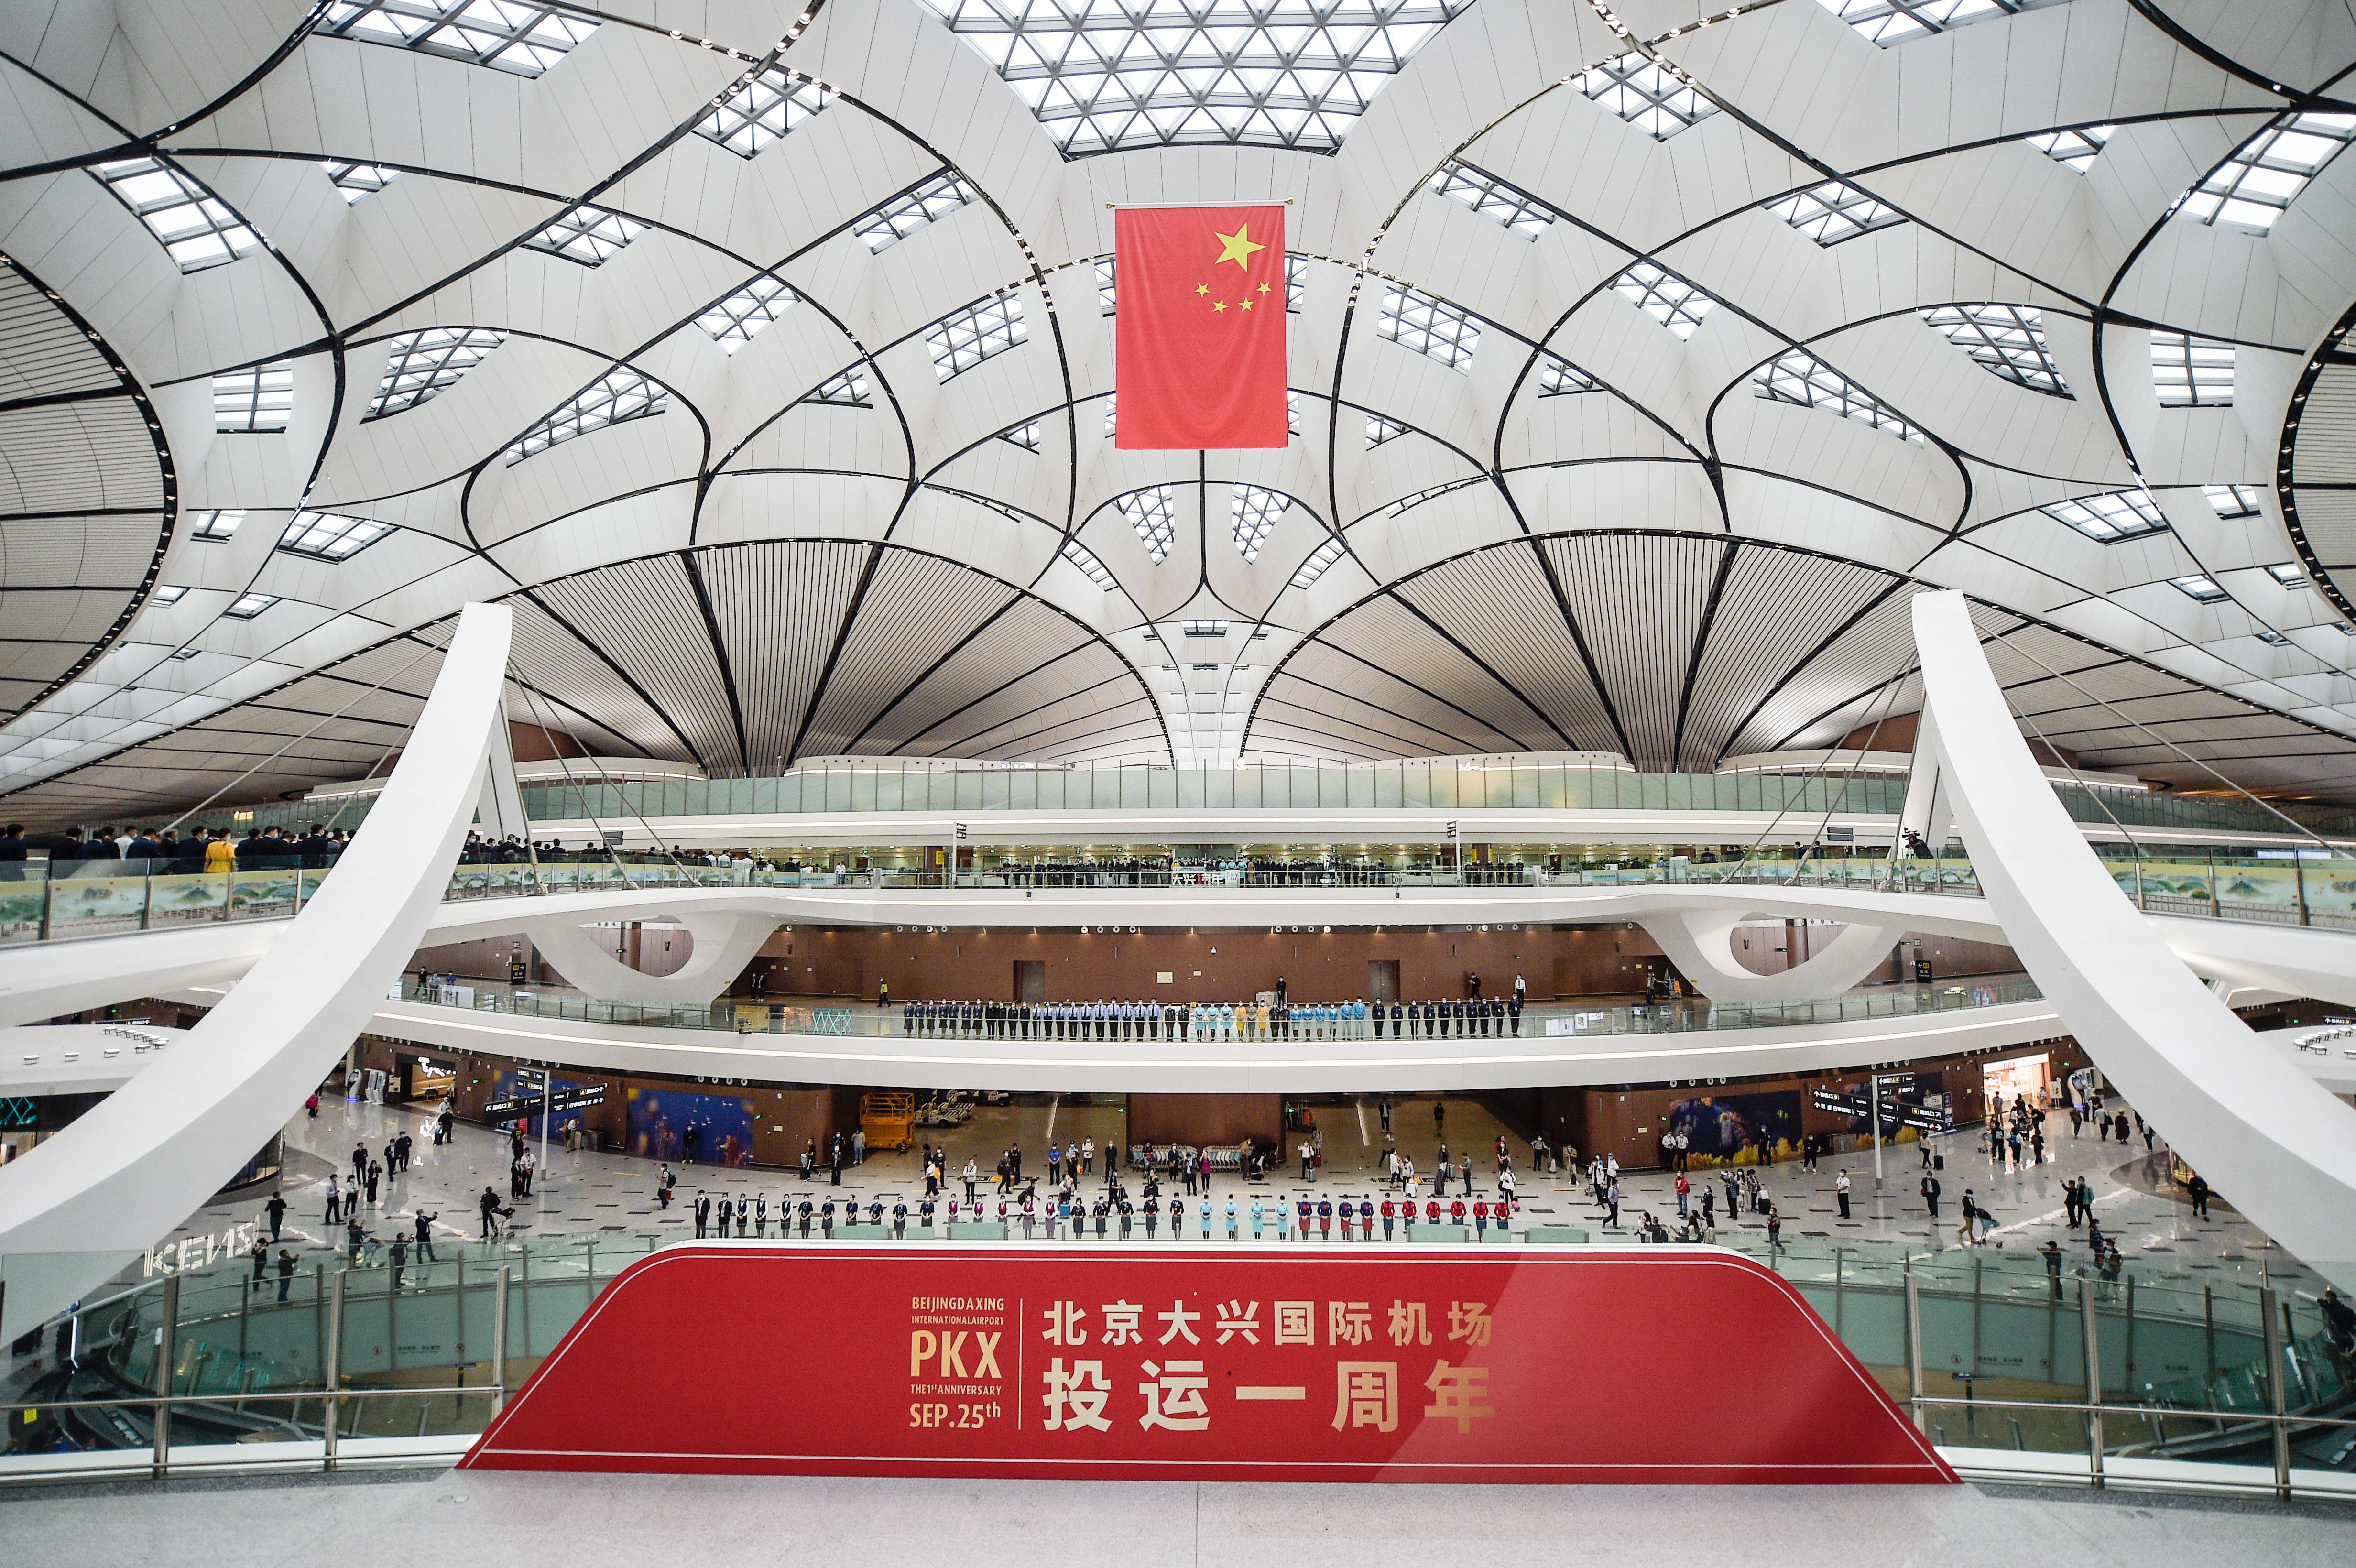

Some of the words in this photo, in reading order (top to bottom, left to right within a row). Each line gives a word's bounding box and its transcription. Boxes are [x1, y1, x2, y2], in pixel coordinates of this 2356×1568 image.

[912, 1296, 1004, 1313] BEIJINGDAXING
[912, 1315, 1004, 1325] INTERNATIONALAIRPORT
[1042, 1299, 1492, 1346] 北京大兴国际机场
[910, 1329, 1002, 1379] PKX
[1042, 1357, 1495, 1433] 投运一周年
[909, 1401, 1001, 1429] SEP.25th
